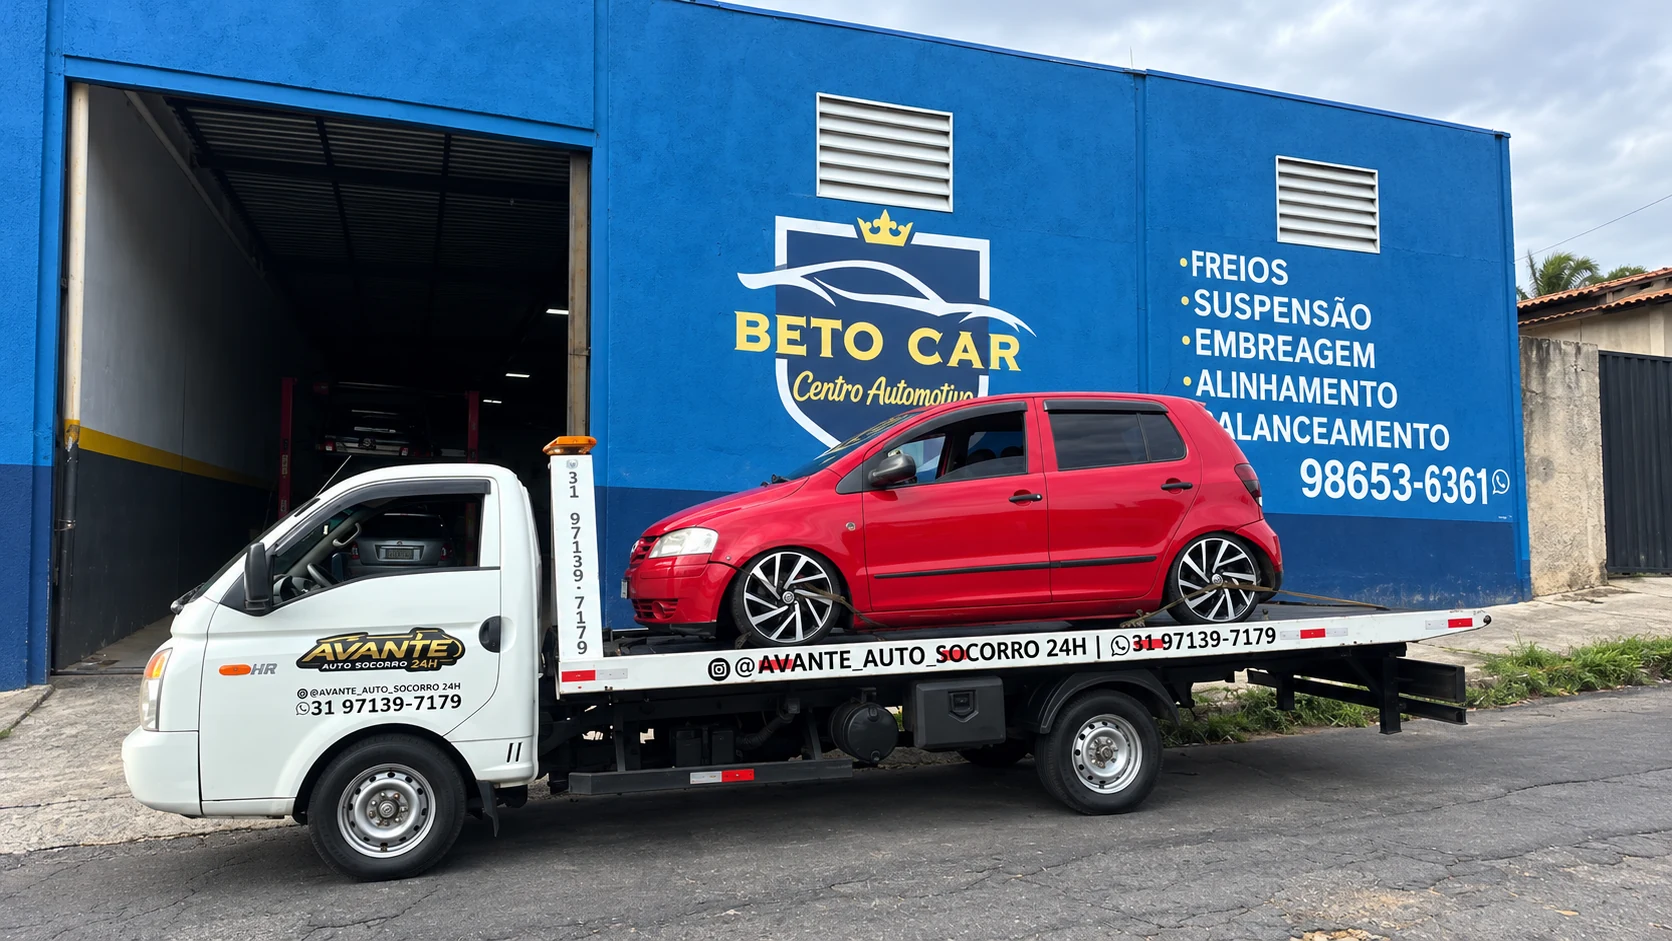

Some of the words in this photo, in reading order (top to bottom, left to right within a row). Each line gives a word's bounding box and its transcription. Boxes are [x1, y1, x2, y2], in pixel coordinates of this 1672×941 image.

[1191, 250, 1289, 286] FREIOS
[1193, 288, 1372, 331] SUSPENSÃO
[734, 311, 883, 361] BETO
[907, 327, 1021, 371] CAR
[1195, 328, 1376, 369] EMBREAGEM
[792, 370, 863, 403] Centro
[1195, 369, 1398, 409] ALINHAMENTO
[1206, 410, 1450, 451] ALANCEAMENTO
[1300, 457, 1488, 505] 98653-6361
[250, 663, 277, 675] HR
[301, 638, 453, 662] AVANTE
[321, 662, 351, 670] AUTO
[355, 660, 407, 669] SOCORRO
[410, 659, 438, 669] 24H
[735, 638, 1040, 678] @AVANTE_AUTO_SOCORRO
[1046, 637, 1087, 657] 24H
[1163, 627, 1276, 650] 97139-7179
[310, 684, 440, 697] @AVANTE_AUTO_SOCORRO
[442, 682, 461, 691] 24H
[311, 700, 334, 716] 31
[342, 693, 462, 715] 97139-7179
